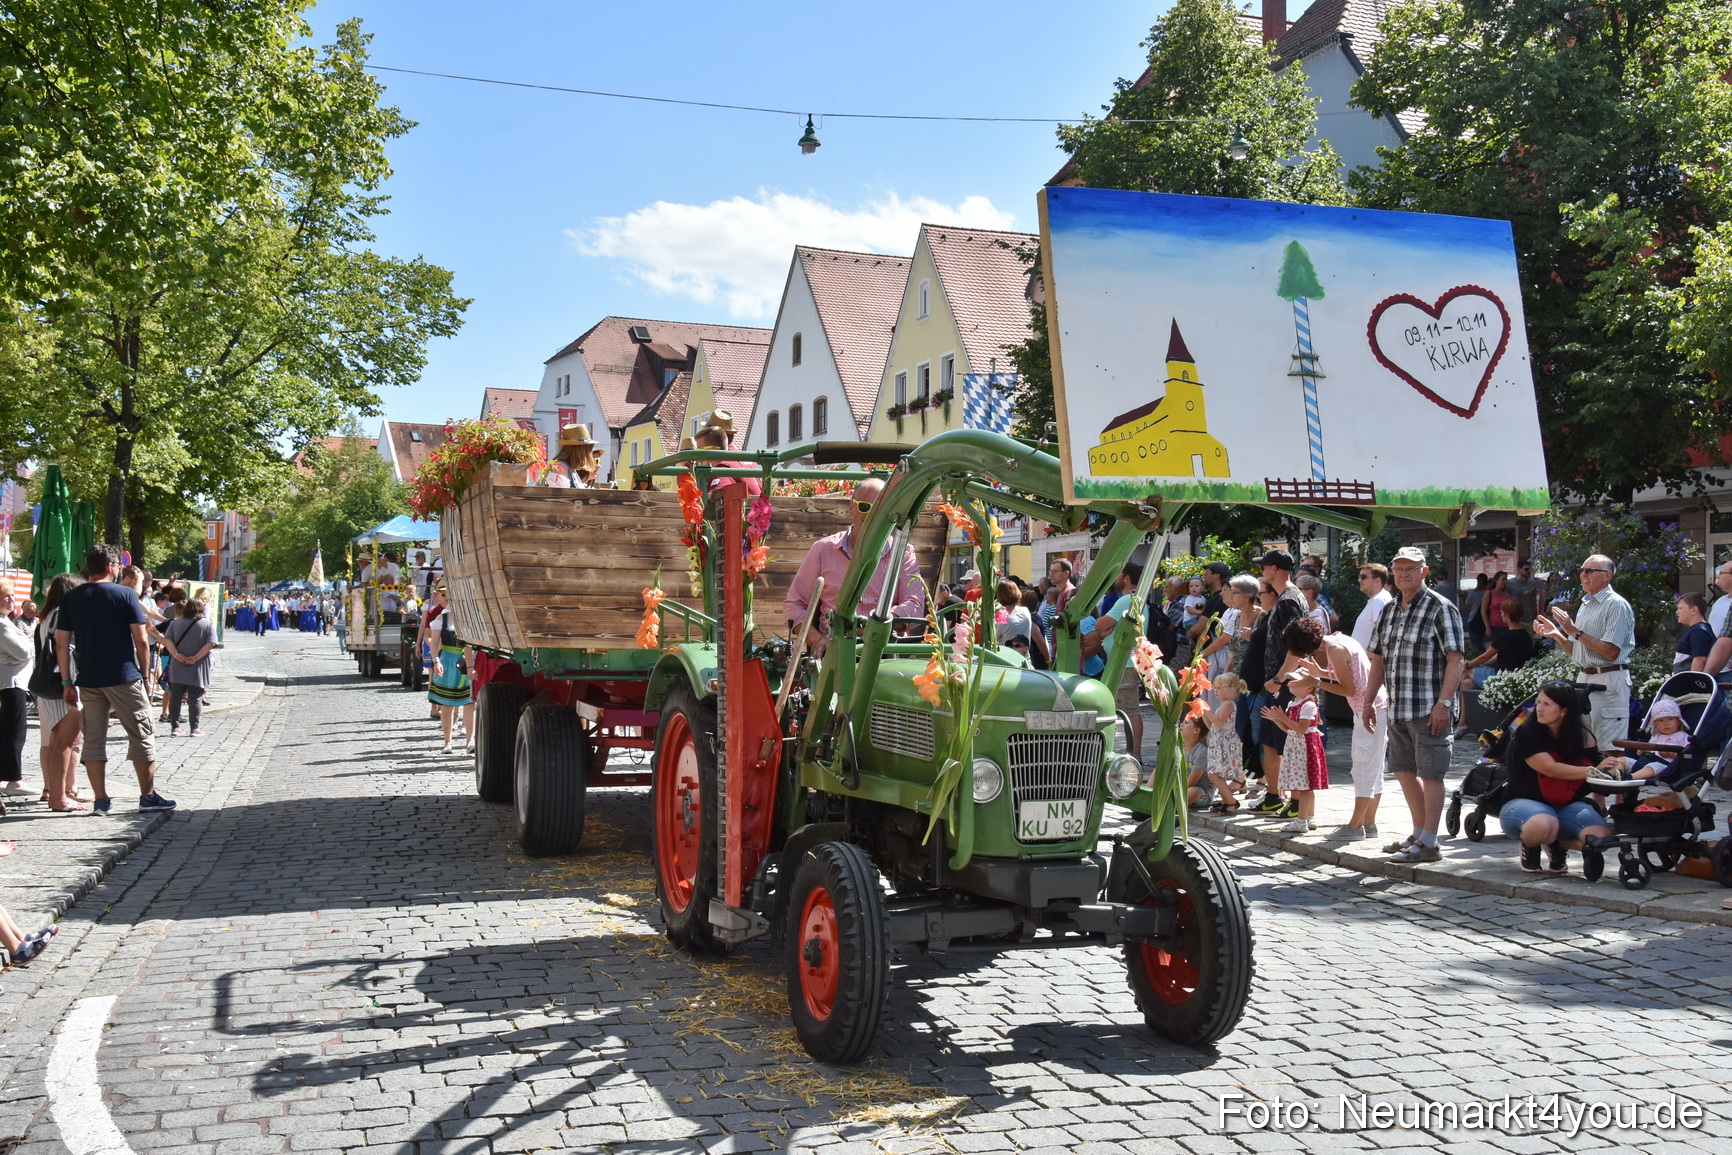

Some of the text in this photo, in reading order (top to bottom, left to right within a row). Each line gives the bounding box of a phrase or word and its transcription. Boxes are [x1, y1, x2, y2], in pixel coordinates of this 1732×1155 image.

[1425, 337, 1490, 372] KIRWA
[1026, 711, 1097, 730] FENDT
[1047, 801, 1075, 819] NM
[1021, 819, 1083, 837] KU 92
